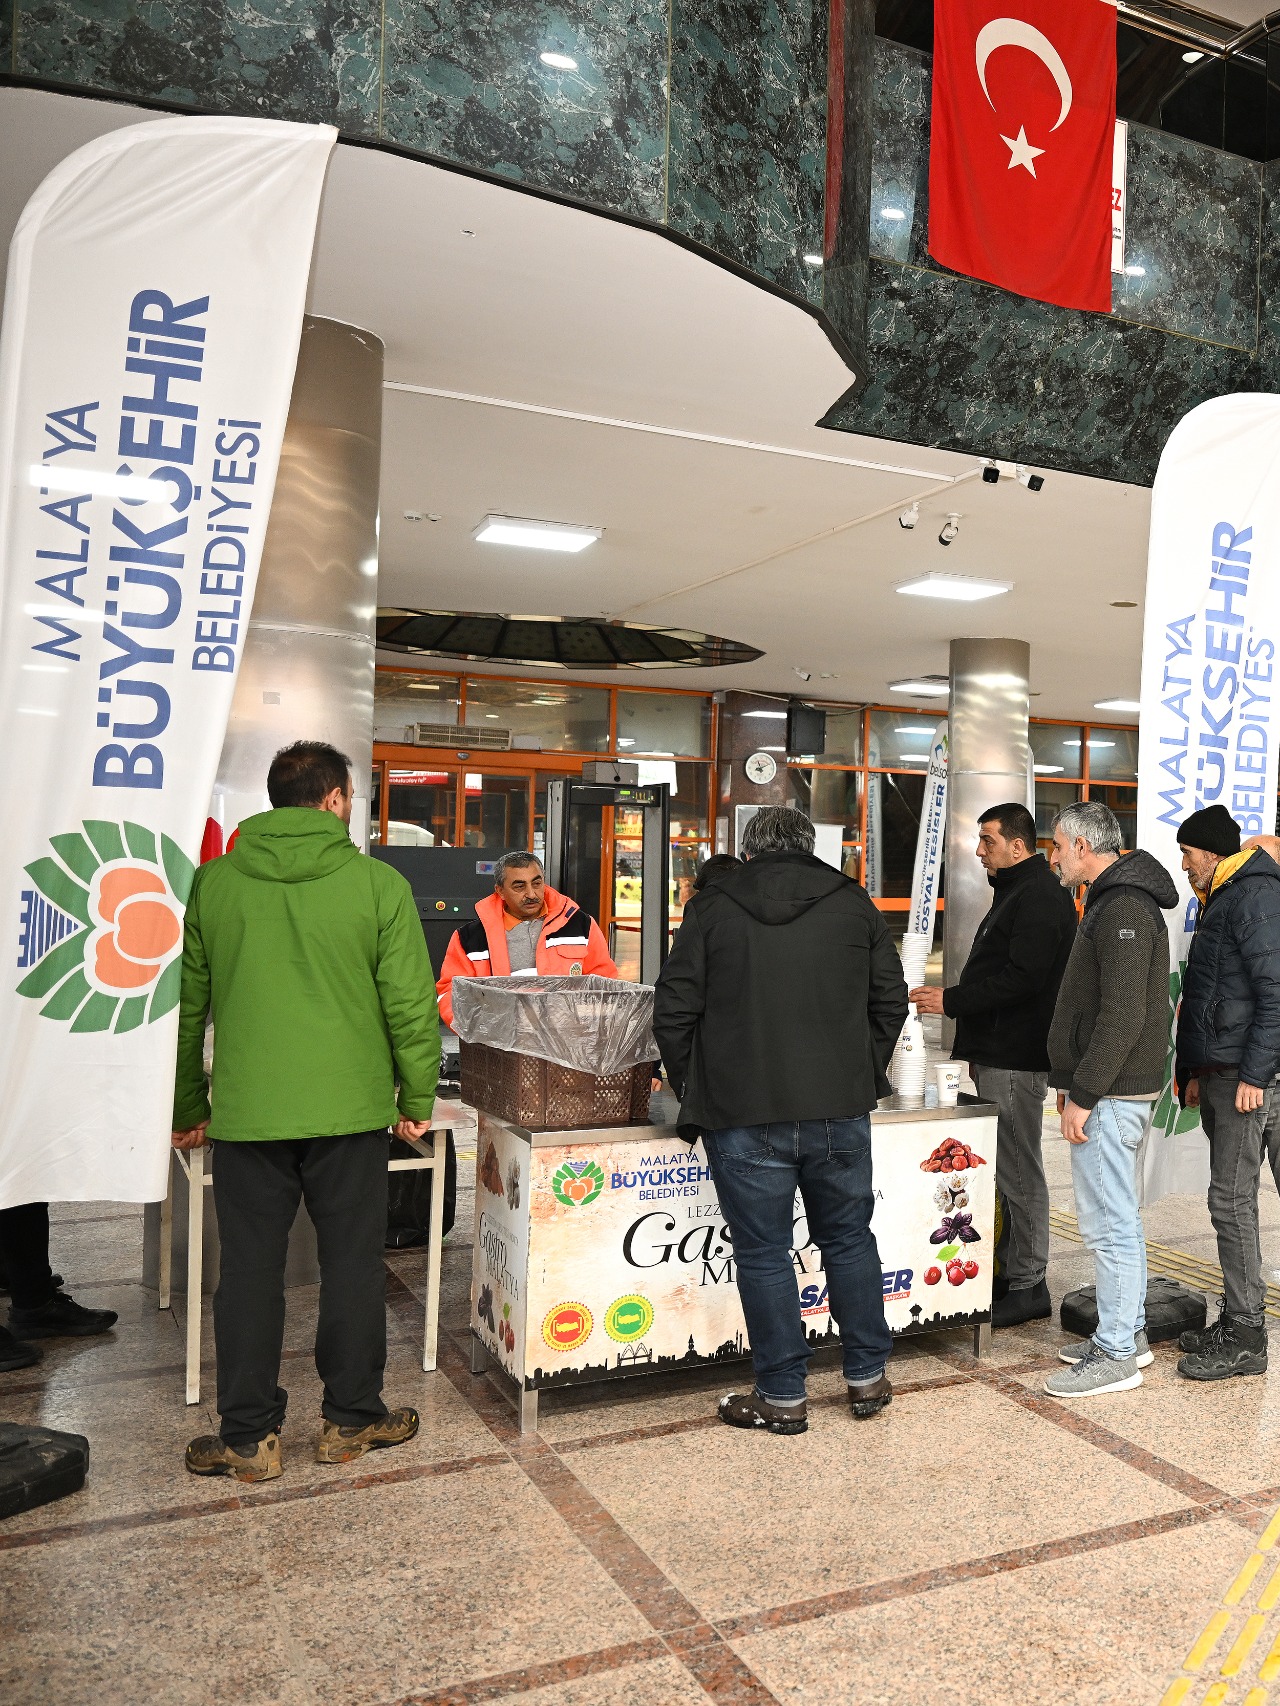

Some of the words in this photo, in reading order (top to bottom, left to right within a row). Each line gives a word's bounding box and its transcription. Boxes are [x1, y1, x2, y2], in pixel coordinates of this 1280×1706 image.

[92, 289, 210, 790] BÜYÜKŞEHİR
[192, 418, 262, 673] BELEDİYESİ
[1156, 613, 1196, 828] MALATYA
[611, 1165, 715, 1190] BÜYÜKŞEH
[639, 1185, 700, 1201] BELEDİYESİ
[640, 1152, 700, 1167] MALATYA
